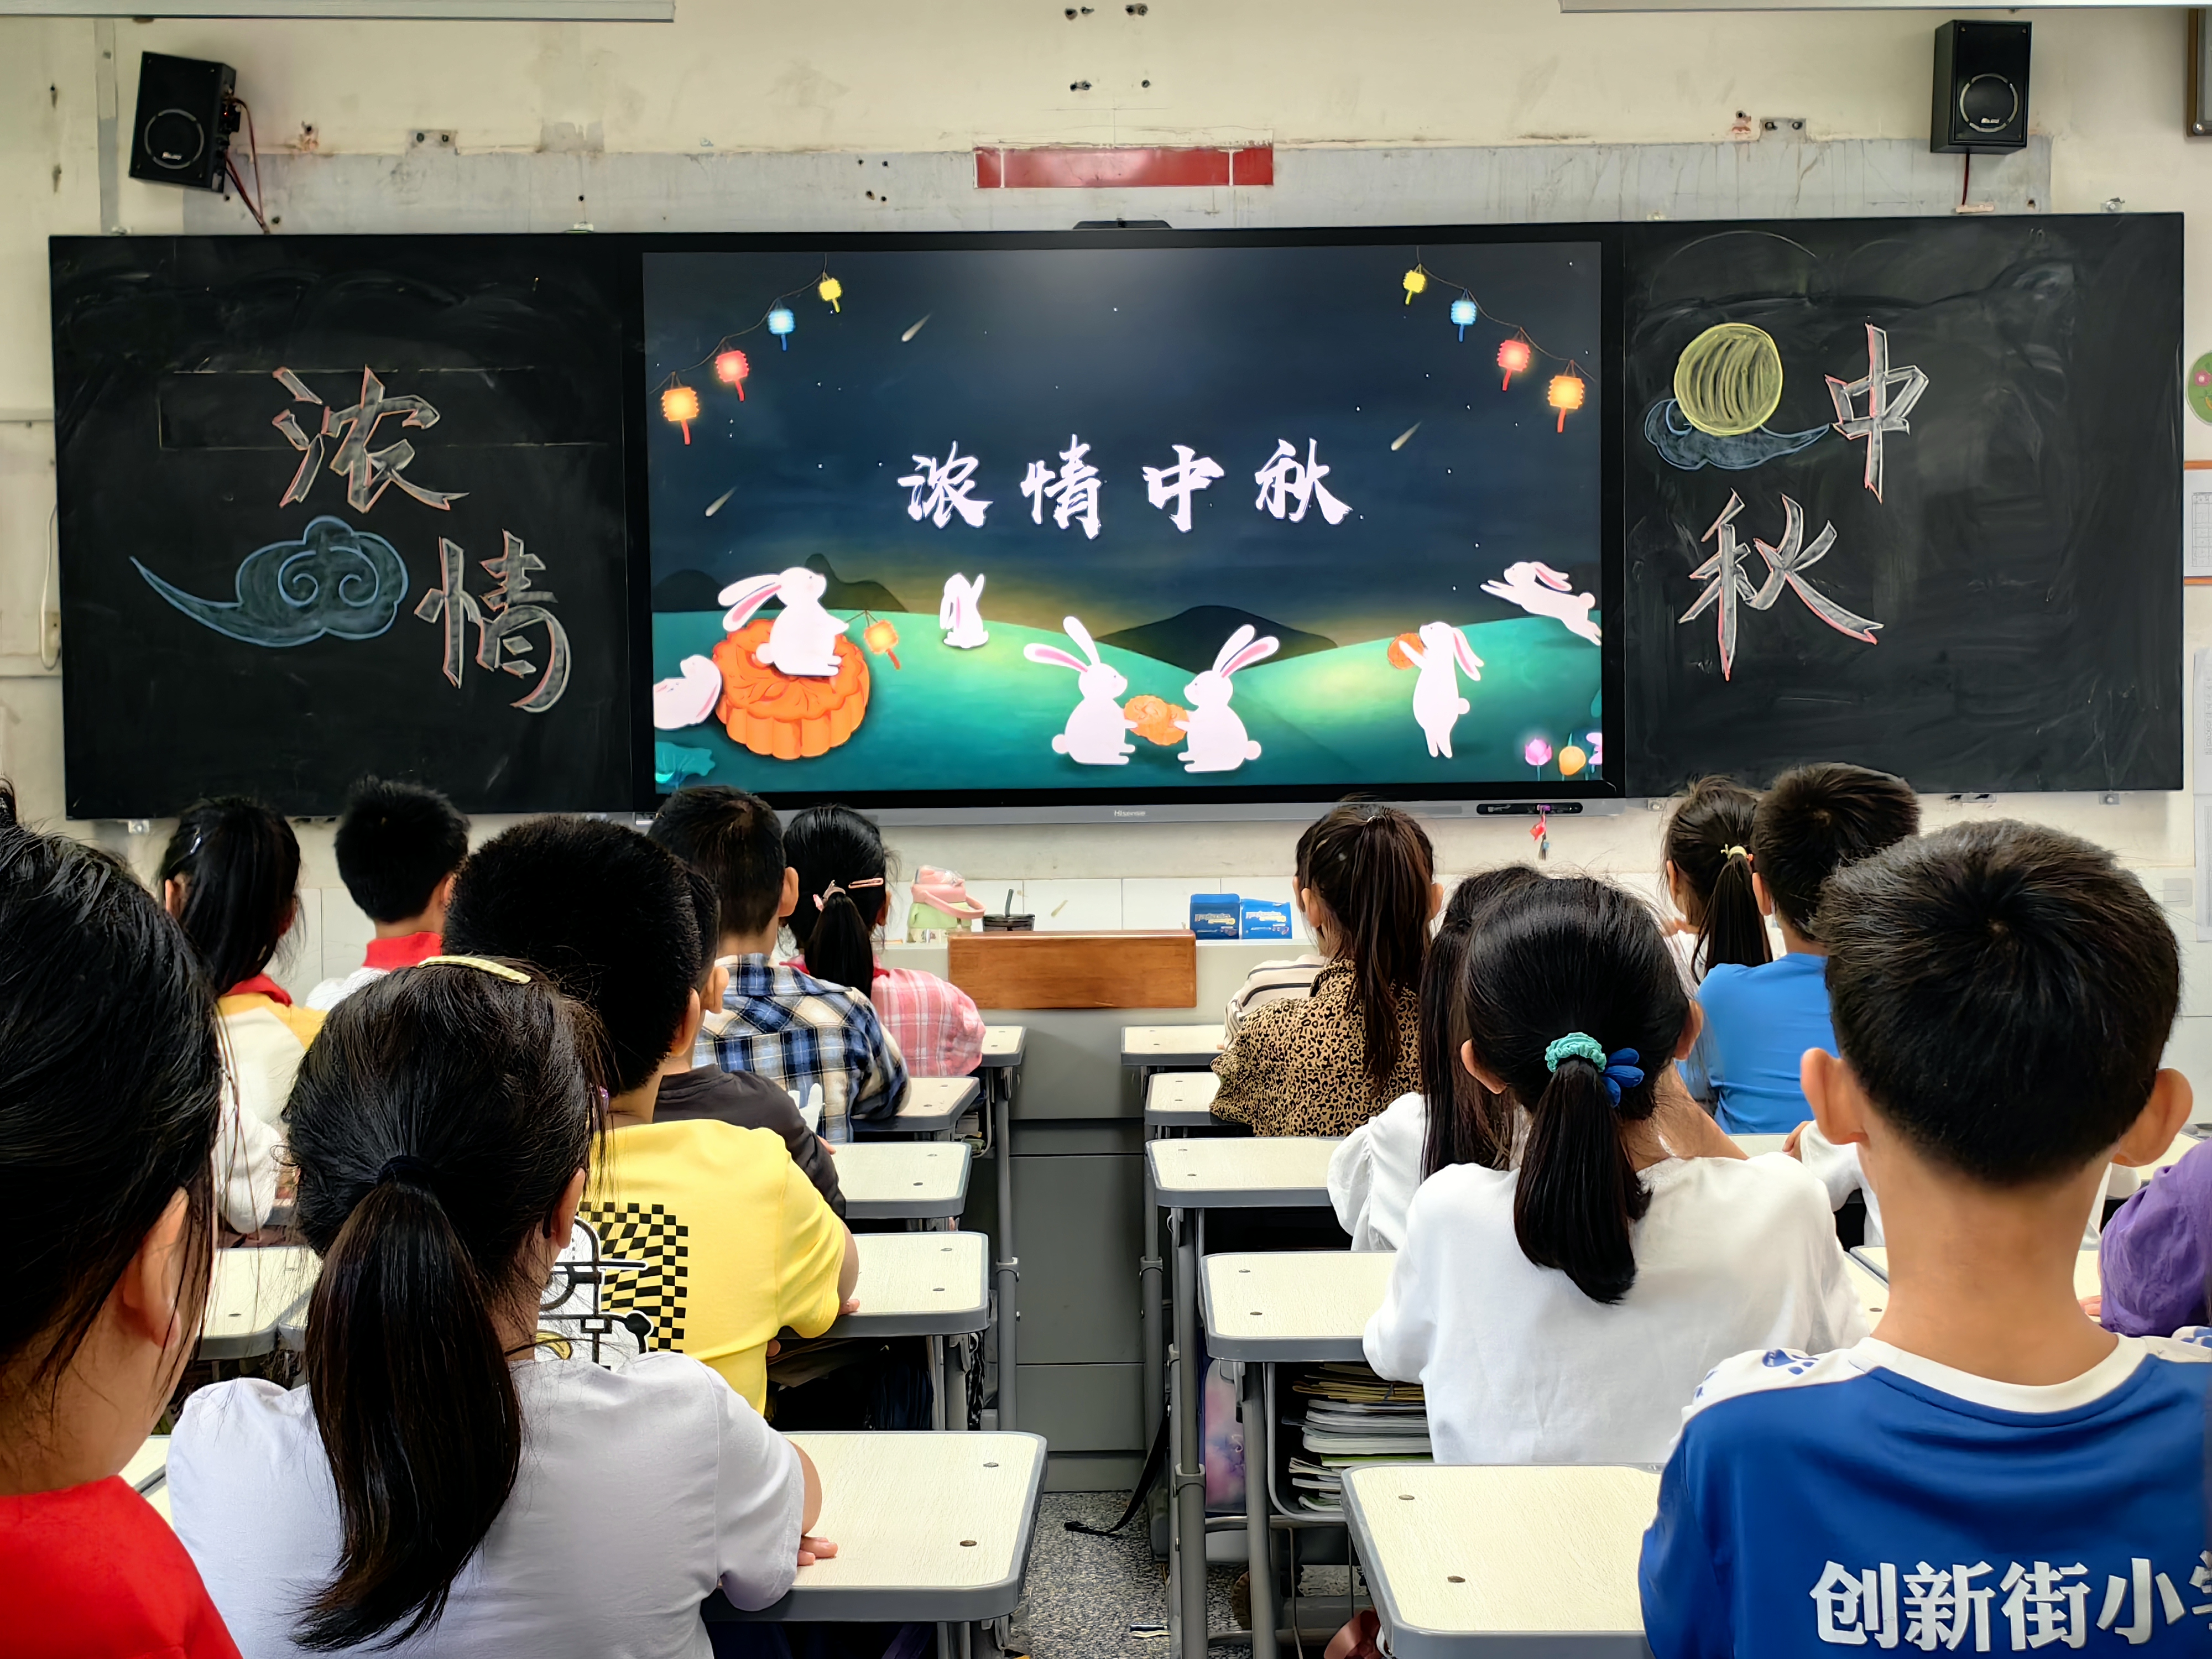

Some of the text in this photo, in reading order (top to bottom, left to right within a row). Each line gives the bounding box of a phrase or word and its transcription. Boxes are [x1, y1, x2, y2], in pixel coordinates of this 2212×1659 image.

[272, 364, 469, 513] 浓
[896, 434, 1353, 540] 浓情中秋
[1824, 321, 1929, 504] 中
[414, 529, 571, 713] 情
[1677, 487, 1885, 681] 秋
